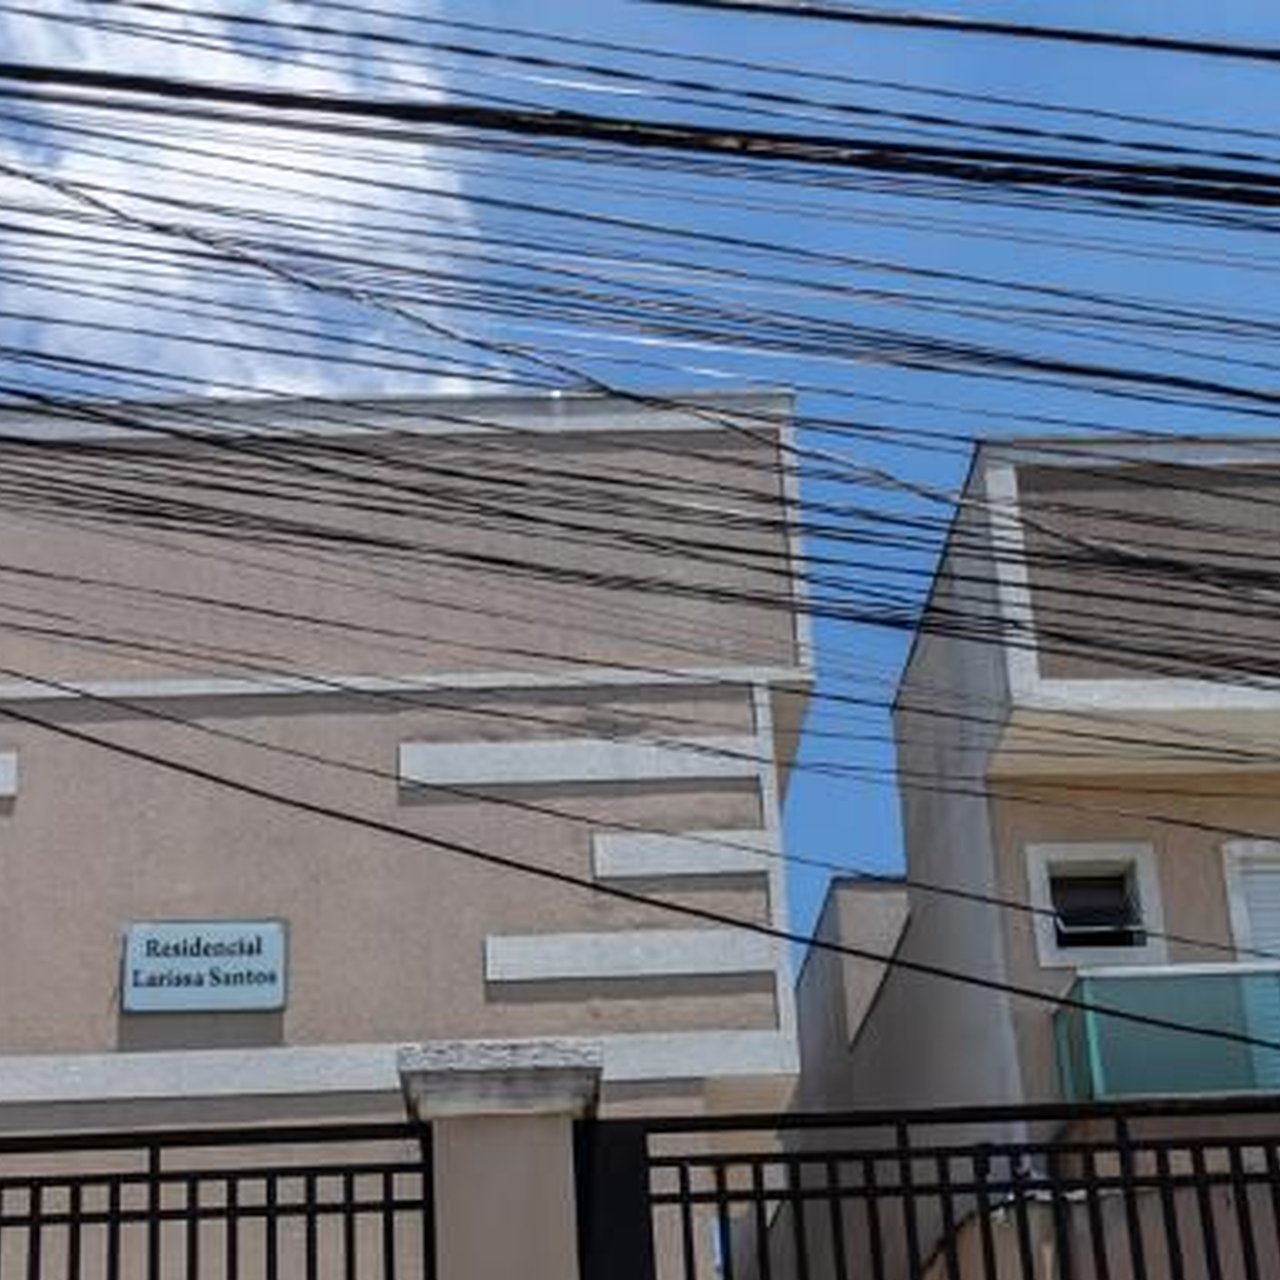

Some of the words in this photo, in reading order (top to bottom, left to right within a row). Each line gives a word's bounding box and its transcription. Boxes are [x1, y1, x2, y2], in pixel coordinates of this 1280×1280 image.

[145, 936, 262, 957] Residencial
[132, 969, 204, 988] Larissa
[209, 966, 277, 986] Santos
